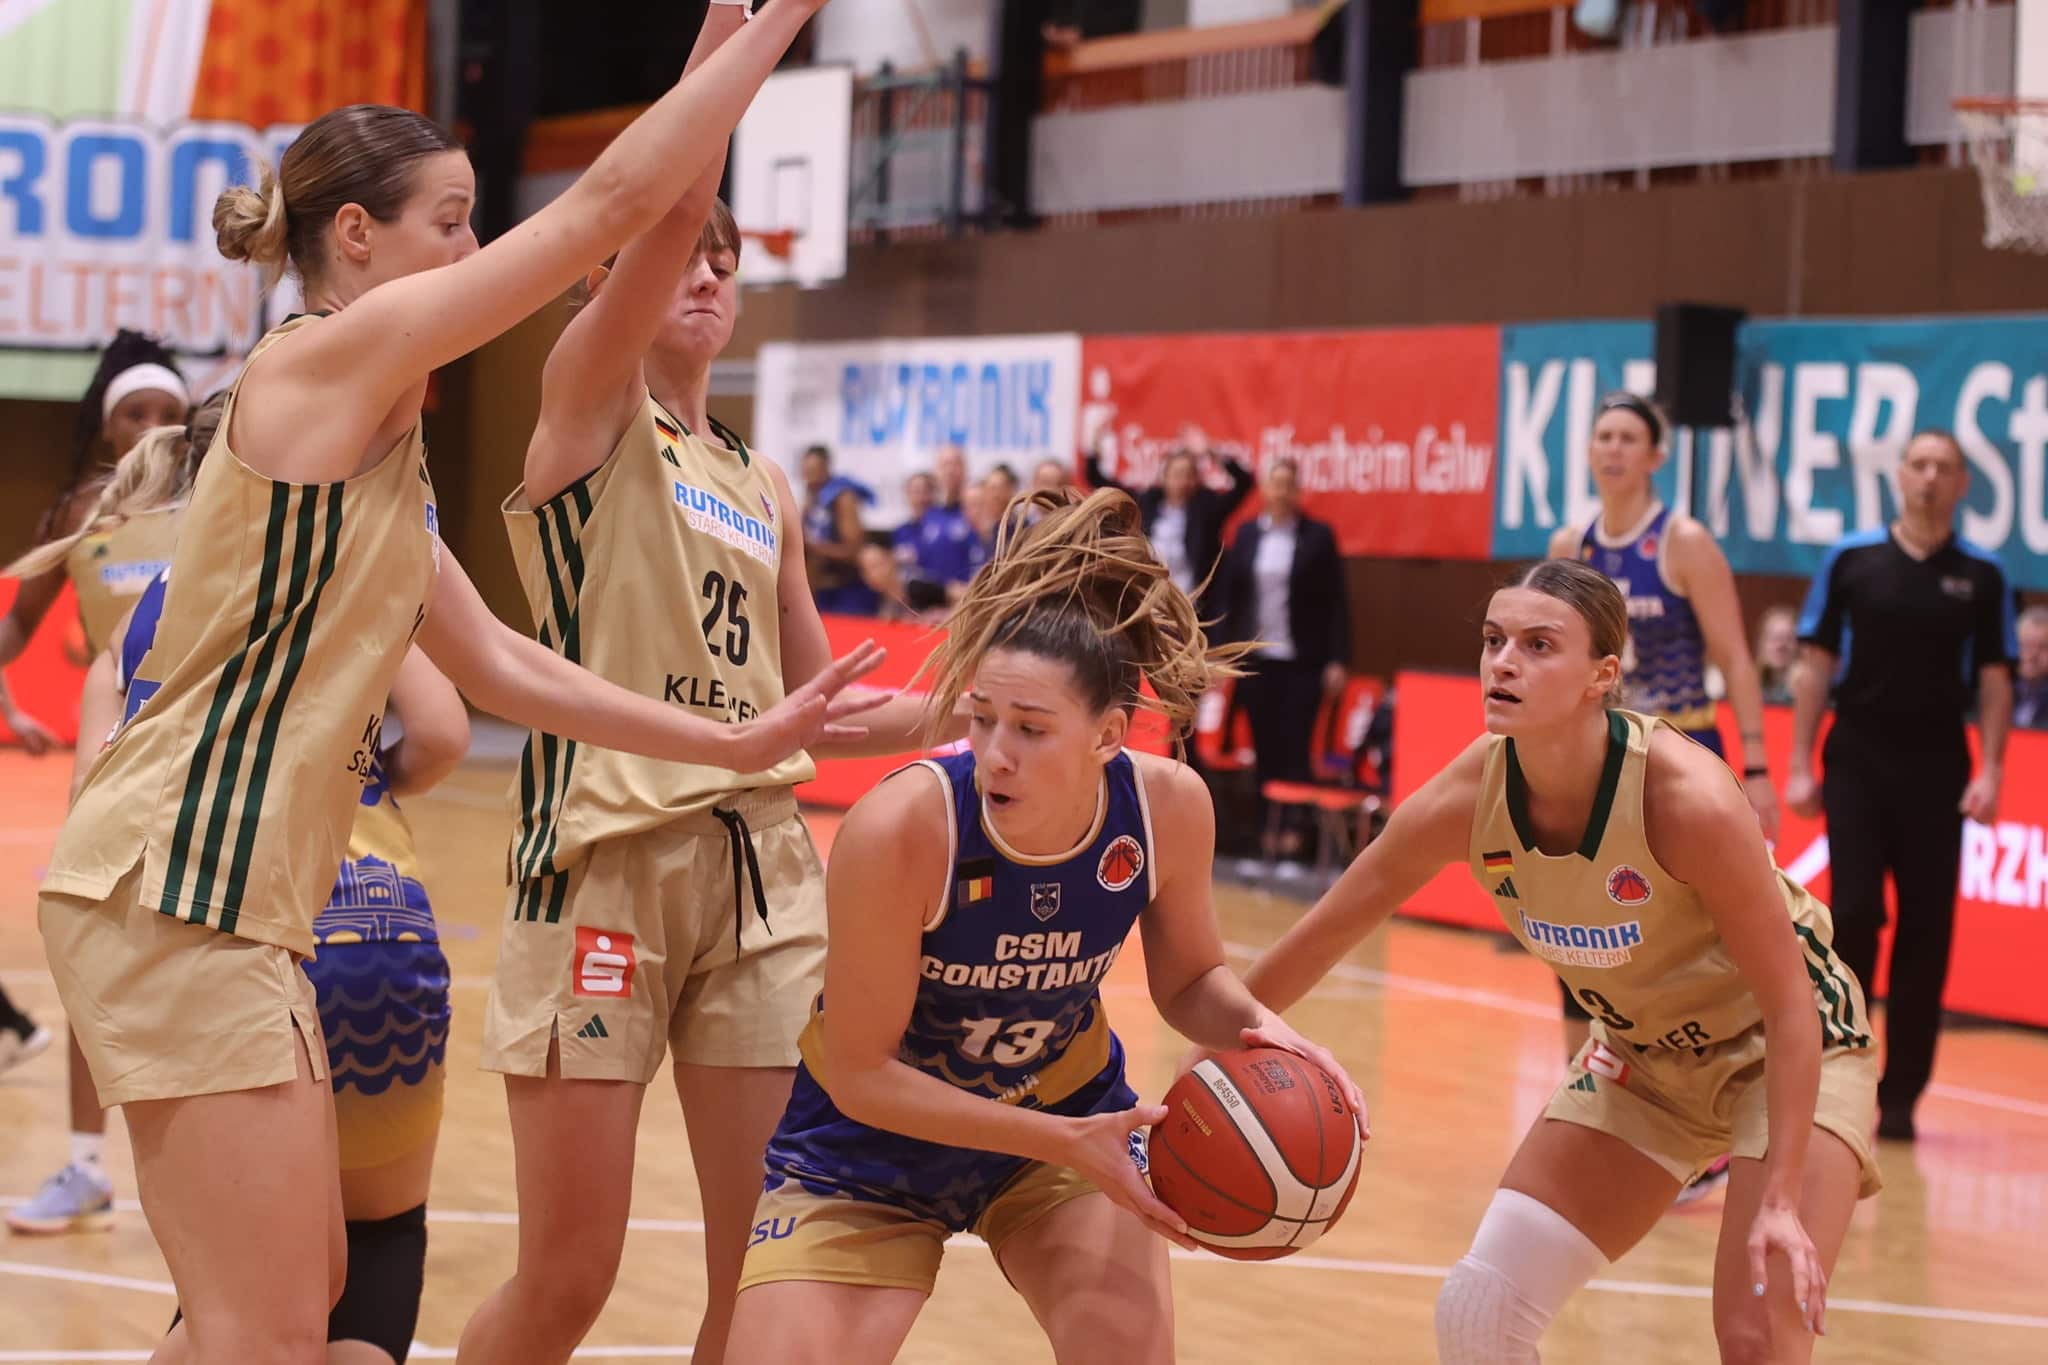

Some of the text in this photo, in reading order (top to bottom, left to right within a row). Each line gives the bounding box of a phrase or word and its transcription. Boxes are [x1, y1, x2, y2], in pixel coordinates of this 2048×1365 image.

[1413, 420, 1493, 492] Calw
[675, 481, 775, 550] RUTRONIK
[702, 570, 750, 666] 25
[995, 930, 1082, 962] CSM
[960, 1016, 1057, 1066] 13
[1213, 1078, 1241, 1110] BG4550
[747, 1216, 797, 1249] SU
